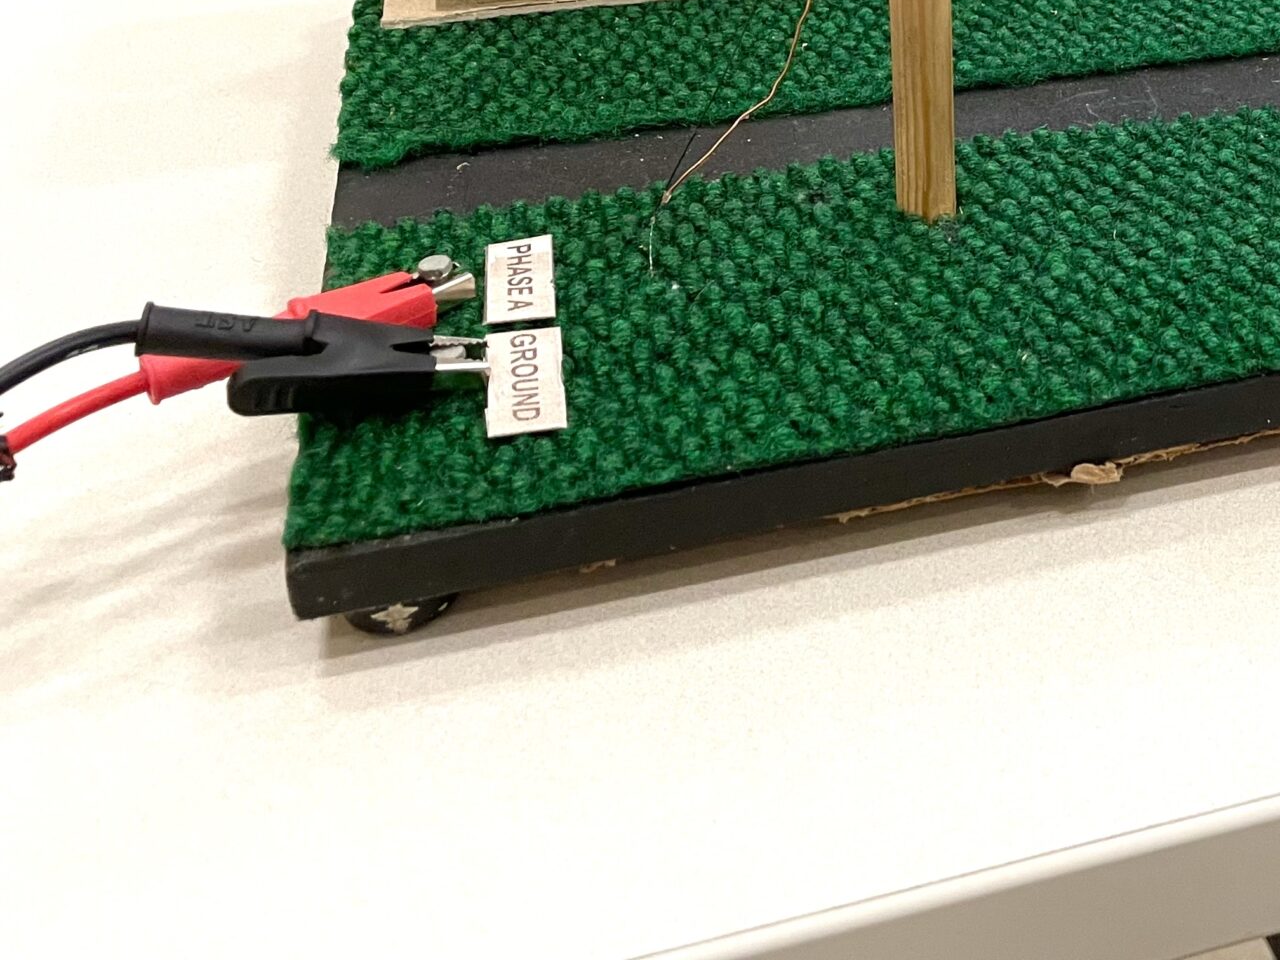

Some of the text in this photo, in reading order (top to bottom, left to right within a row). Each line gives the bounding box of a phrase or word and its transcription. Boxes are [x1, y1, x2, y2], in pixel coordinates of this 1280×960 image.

[507, 244, 534, 312] PHASE A
[510, 333, 541, 421] GROUND
